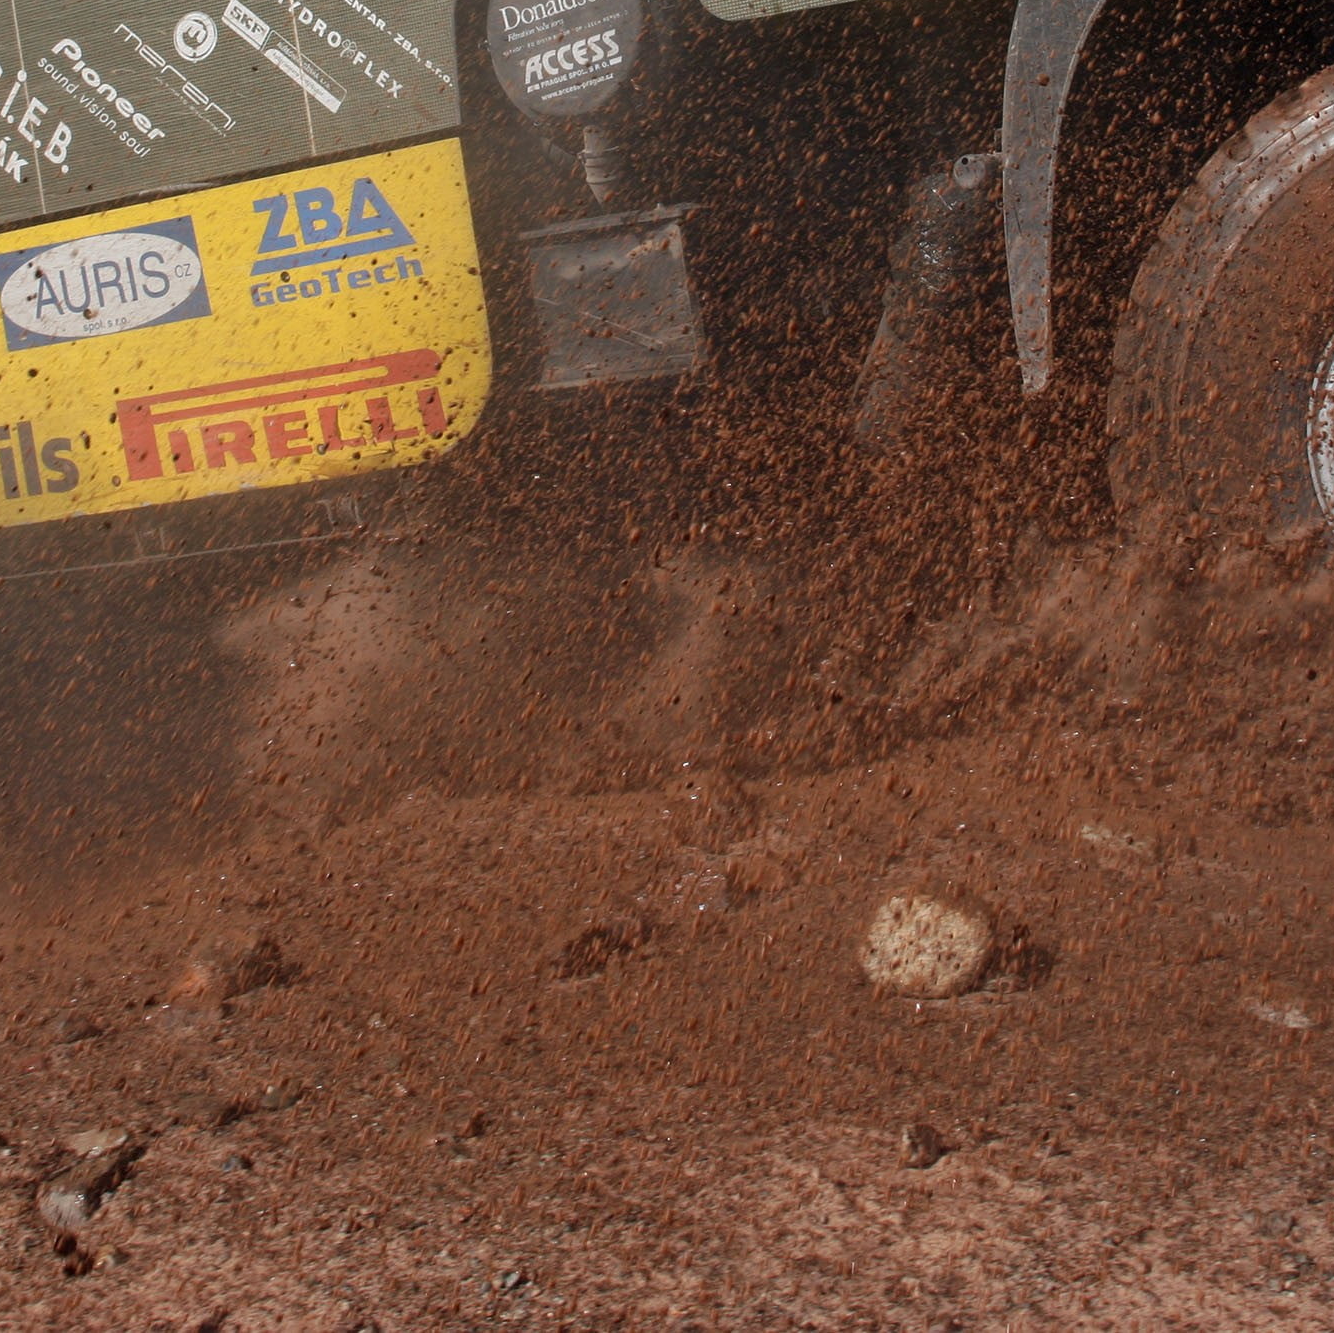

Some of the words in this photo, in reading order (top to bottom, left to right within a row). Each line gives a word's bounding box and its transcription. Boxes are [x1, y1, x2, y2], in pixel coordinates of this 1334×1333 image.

[229, 4, 265, 37] SKF
[525, 29, 619, 84] ACCESS
[51, 38, 165, 140] Pioneer
[255, 177, 414, 254] ZBA
[35, 251, 171, 320] AURIS
[116, 347, 448, 482] PIRELLI
